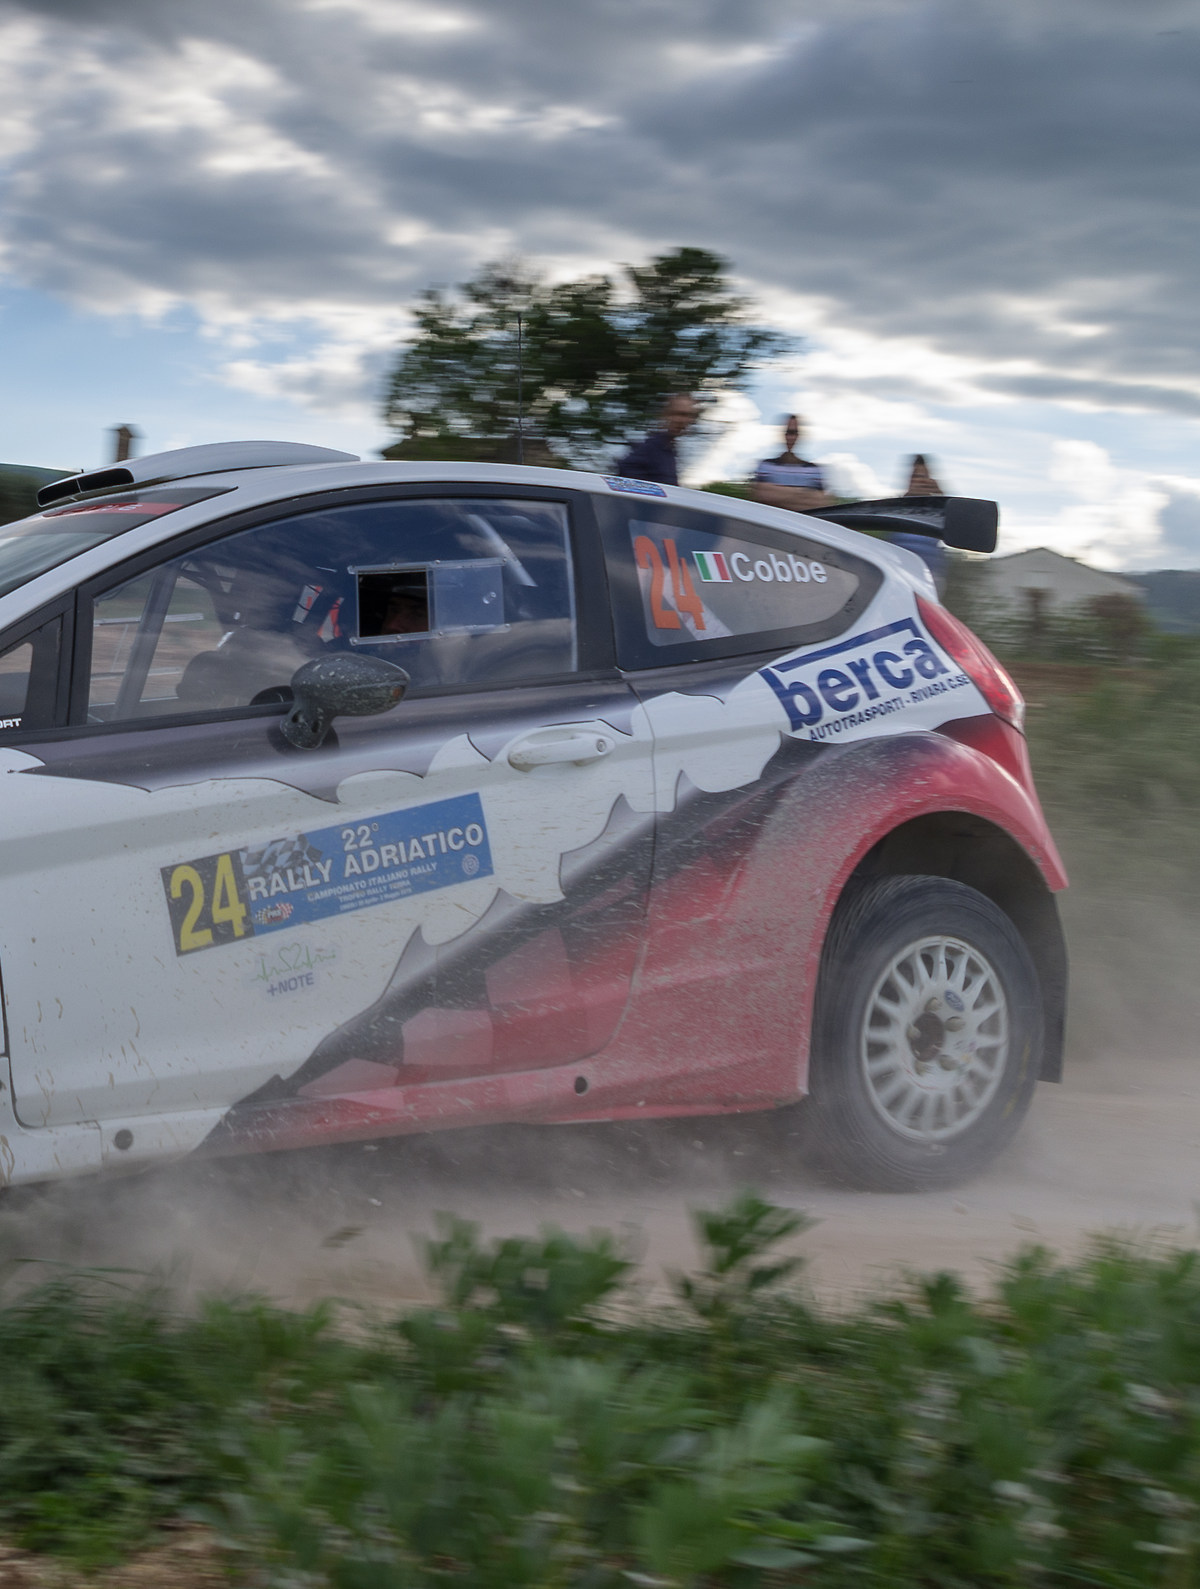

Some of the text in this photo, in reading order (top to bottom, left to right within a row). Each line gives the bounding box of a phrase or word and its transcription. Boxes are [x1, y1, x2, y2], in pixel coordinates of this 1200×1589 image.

[633, 535, 707, 631] 24
[730, 551, 828, 583] Cobbe
[758, 632, 951, 733] berca
[809, 696, 906, 742] AUTOTRASPORTI
[910, 682, 948, 704] RIVARA
[247, 859, 334, 902] RALLY
[343, 822, 485, 878] ADRIATICO
[307, 880, 367, 902] CAMPIONATO
[367, 869, 409, 887] ITALIANO
[410, 861, 438, 877] RALLY
[170, 853, 247, 952] 24
